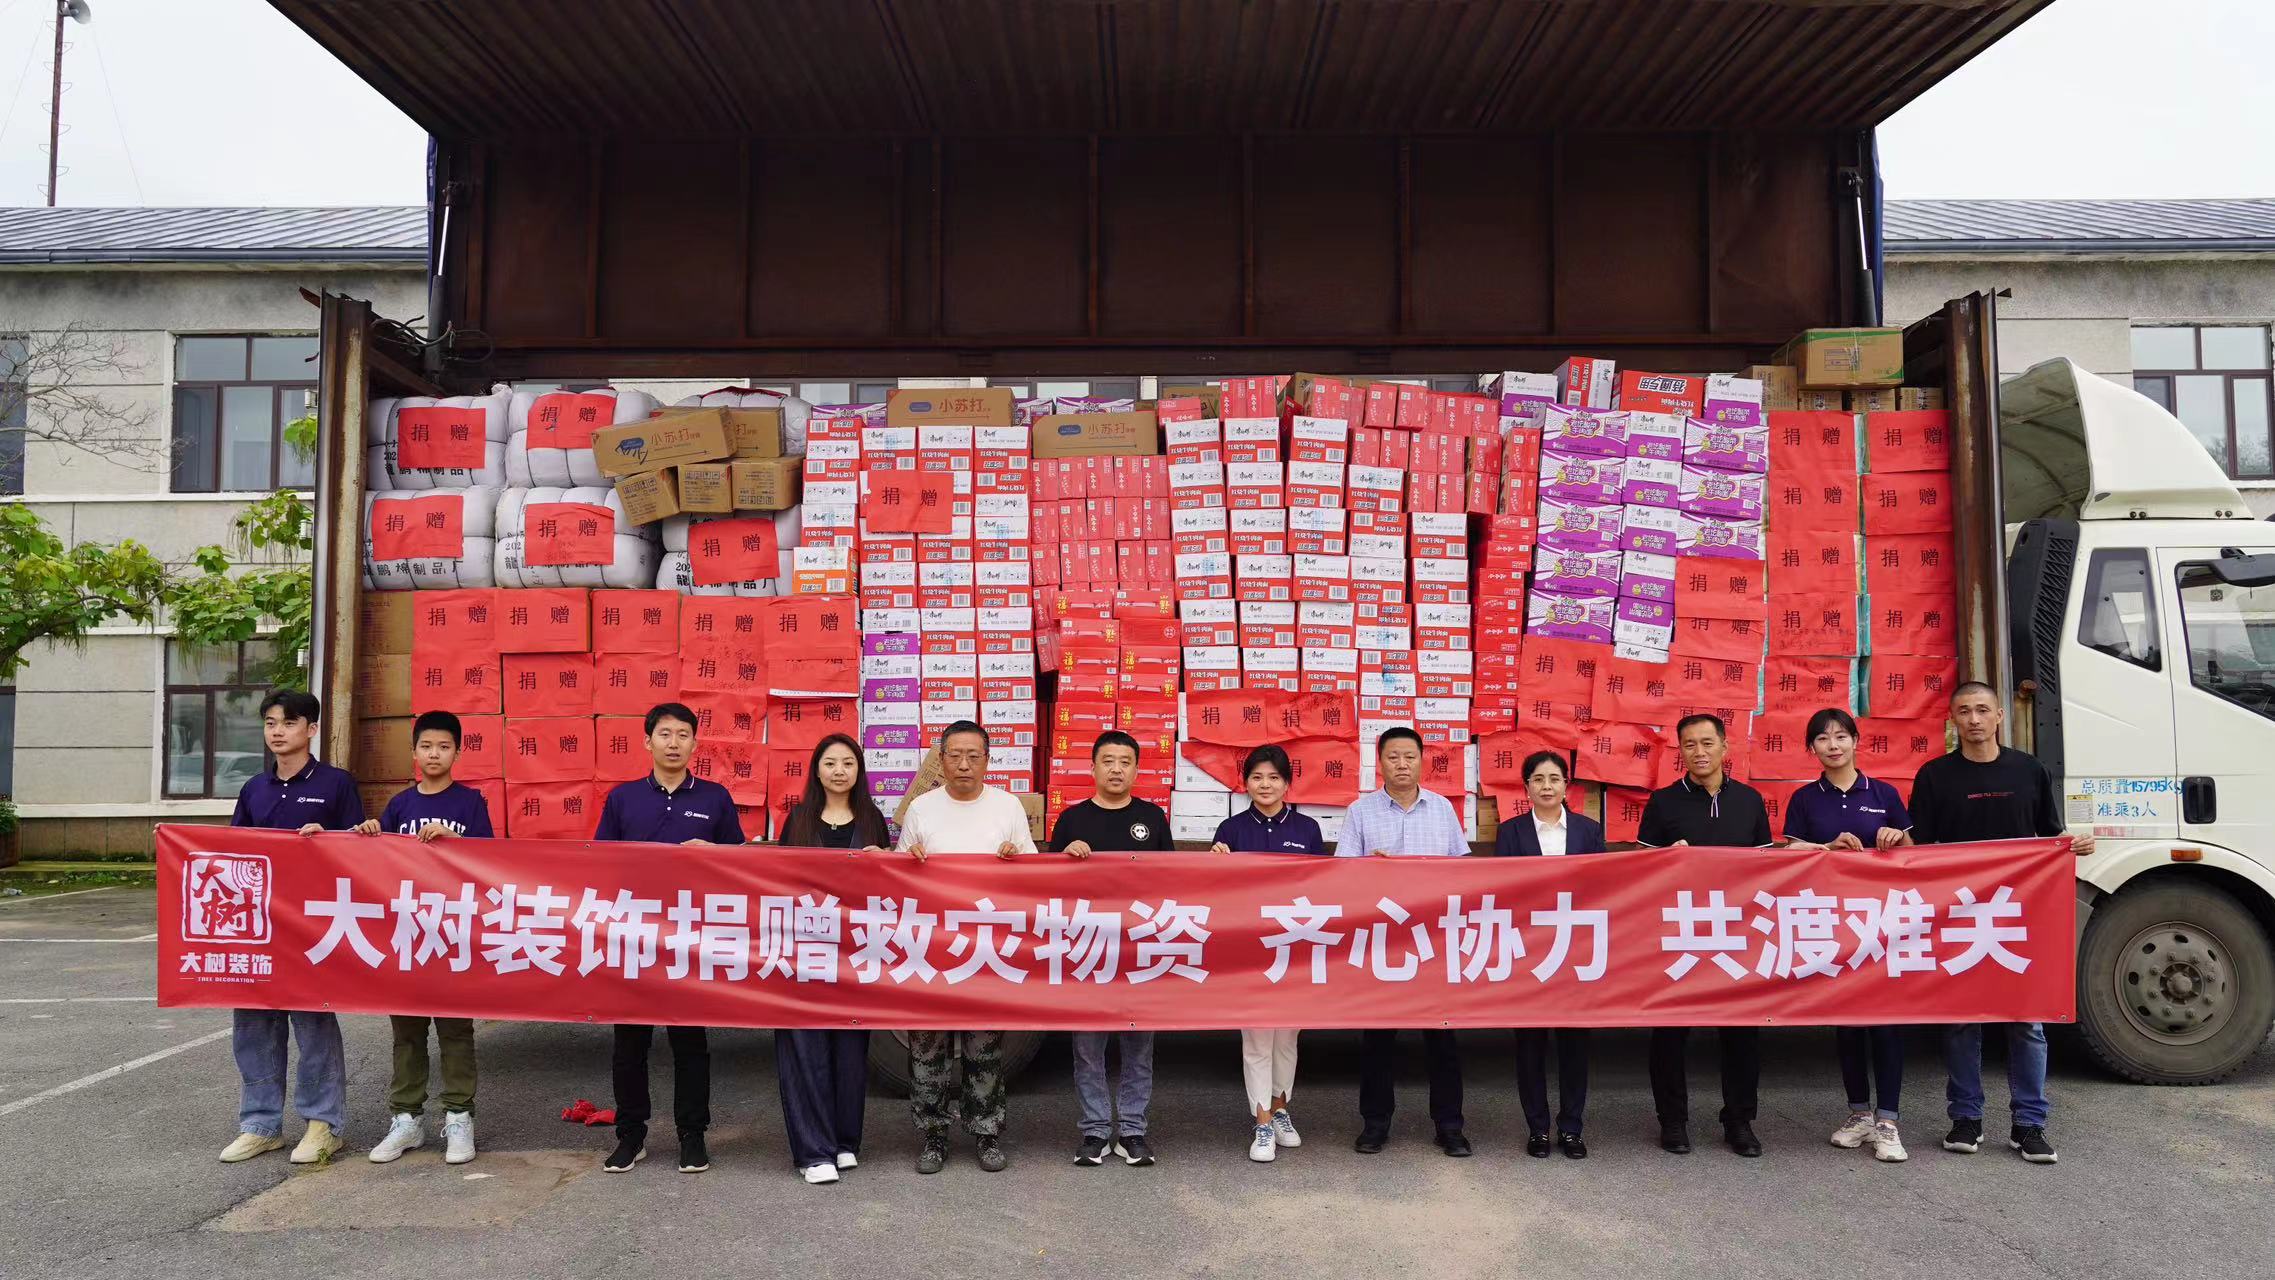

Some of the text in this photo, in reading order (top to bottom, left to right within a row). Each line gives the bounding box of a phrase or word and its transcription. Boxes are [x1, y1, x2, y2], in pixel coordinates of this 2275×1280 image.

[540, 406, 596, 422] 捐赠
[939, 399, 984, 412] 小苏打
[411, 424, 469, 442] 捐赠
[651, 427, 690, 445] 小苏打
[1088, 423, 1124, 434] 小苏打
[1784, 427, 1840, 445] 捐赠
[1884, 427, 1943, 446] 捐赠
[882, 486, 937, 507] 捐赠
[1784, 487, 1841, 505] 捐赠
[1880, 488, 1937, 507] 捐赠
[386, 512, 445, 532] 捐赠
[538, 519, 597, 537] 捐赠
[703, 534, 761, 556] 捐赠
[1782, 547, 1839, 567] 捐赠
[1882, 549, 1938, 567] 捐赠
[1690, 574, 1747, 594] 捐赠
[428, 605, 487, 626] 捐赠
[510, 605, 569, 625] 捐赠
[602, 607, 661, 625] 捐赠
[695, 614, 753, 632] 捐赠
[780, 613, 838, 632] 捐赠
[1783, 610, 1840, 628] 捐赠
[1886, 610, 1941, 629] 捐赠
[698, 659, 756, 681] 捐赠
[1536, 654, 1595, 678] 捐赠
[1684, 661, 1743, 682] 捐赠
[425, 667, 483, 686] 捐赠
[519, 670, 577, 689] 捐赠
[609, 668, 668, 688] 捐赠
[1607, 674, 1664, 697] 捐赠
[1779, 673, 1834, 692] 捐赠
[1886, 673, 1942, 691] 捐赠
[695, 708, 751, 730] 捐赠
[784, 704, 842, 722] 捐赠
[1202, 706, 1261, 724] 捐赠
[1282, 708, 1341, 728] 捐赠
[1533, 700, 1592, 723] 捐赠
[518, 735, 578, 755] 捐赠
[1593, 736, 1650, 760] 捐赠
[1870, 735, 1928, 753] 捐赠
[694, 758, 751, 778] 捐赠
[522, 797, 581, 816] 捐赠
[2097, 801, 2157, 818] 准乘3人
[192, 857, 258, 938] 大树
[304, 877, 2032, 985] 大树装饰捐赠救灾物资 齐心协力 共渡难关
[180, 952, 272, 975] 大树装饰
